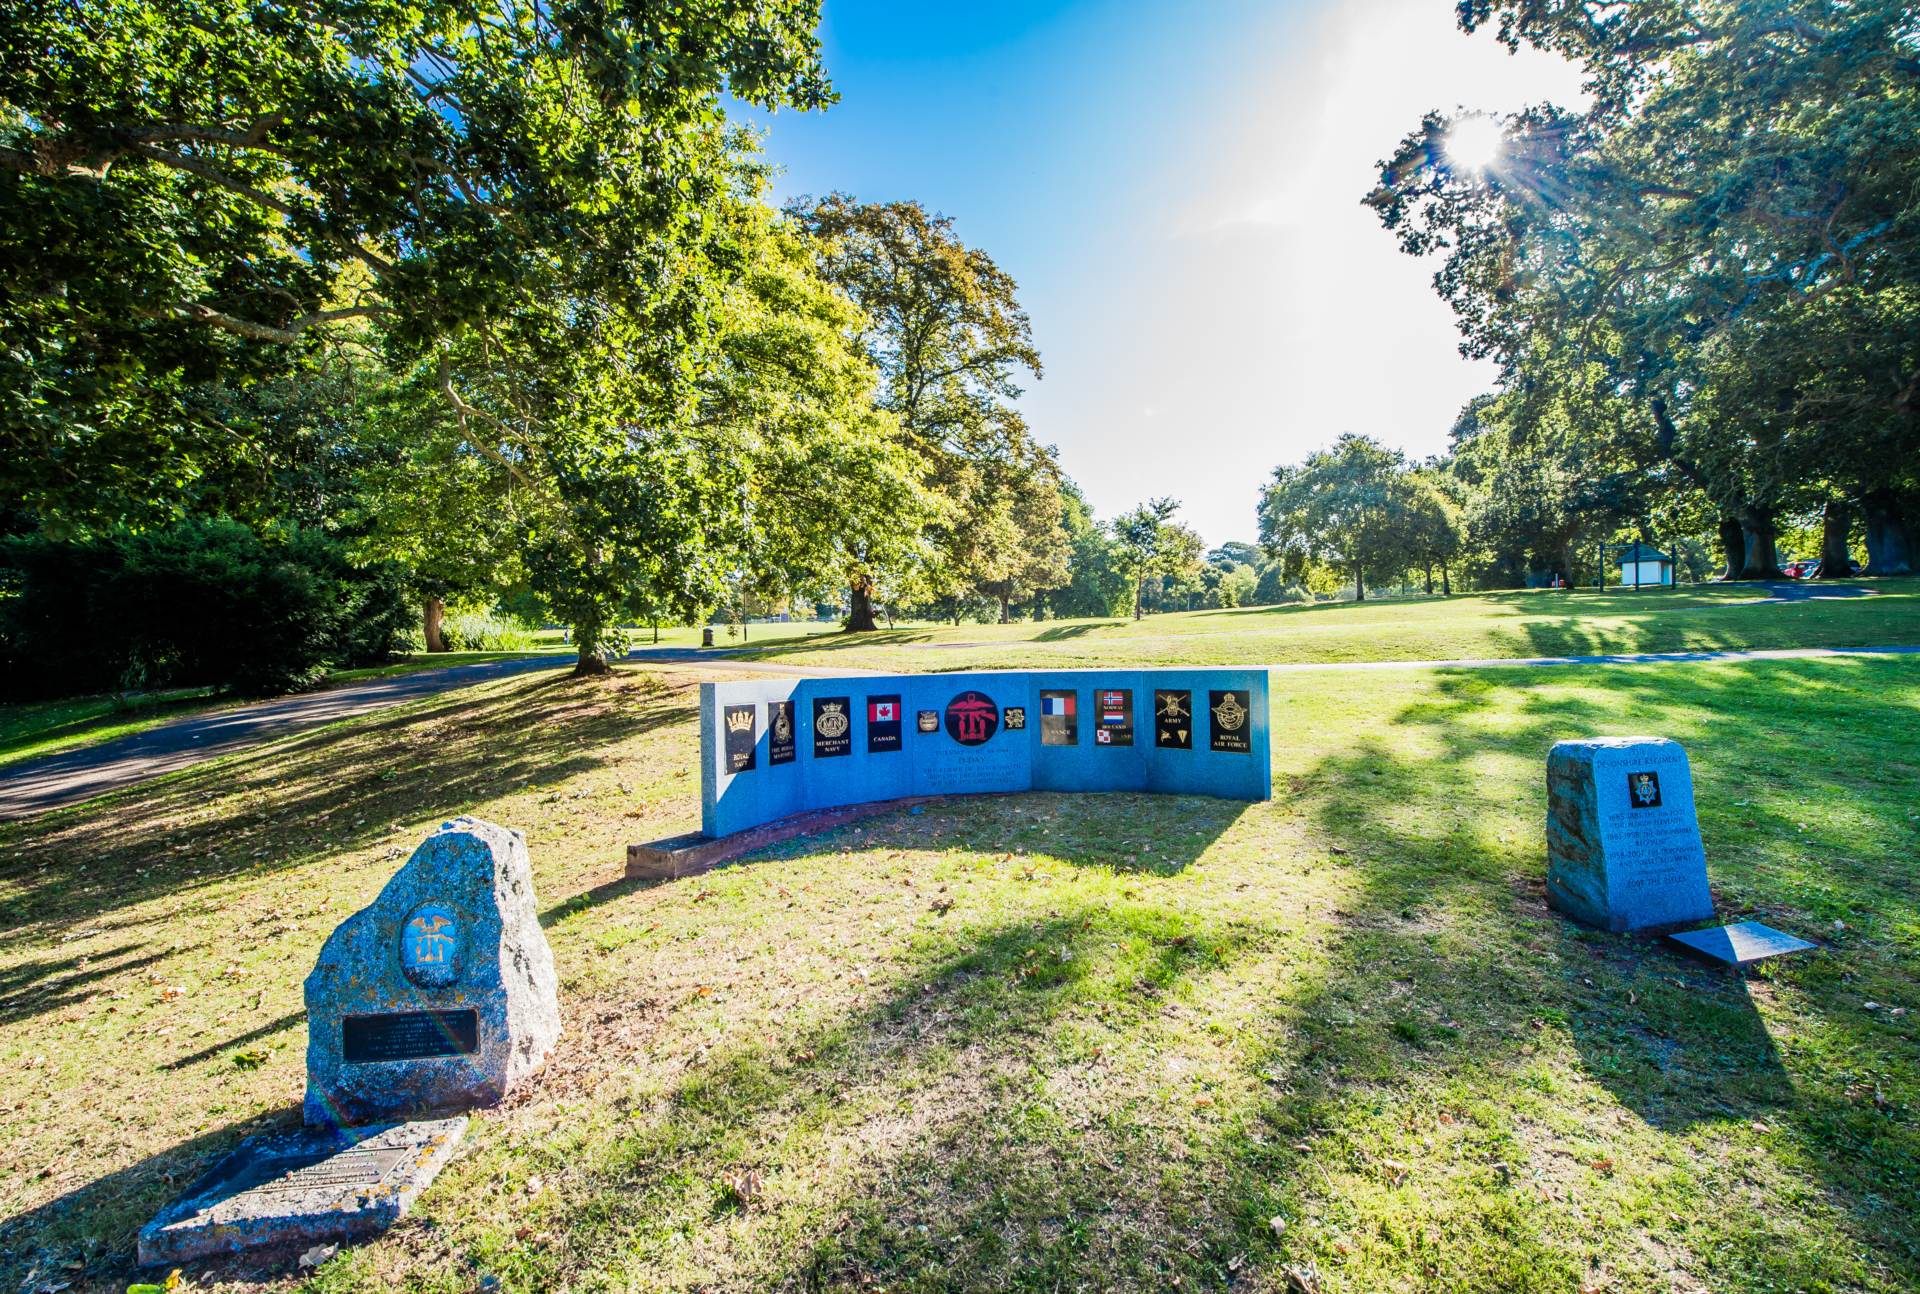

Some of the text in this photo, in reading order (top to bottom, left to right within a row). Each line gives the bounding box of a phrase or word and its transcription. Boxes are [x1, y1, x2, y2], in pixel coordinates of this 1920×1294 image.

[816, 738, 849, 747] MERCHANT
[1227, 741, 1248, 749] FORCE
[733, 752, 750, 761] ROYAL
